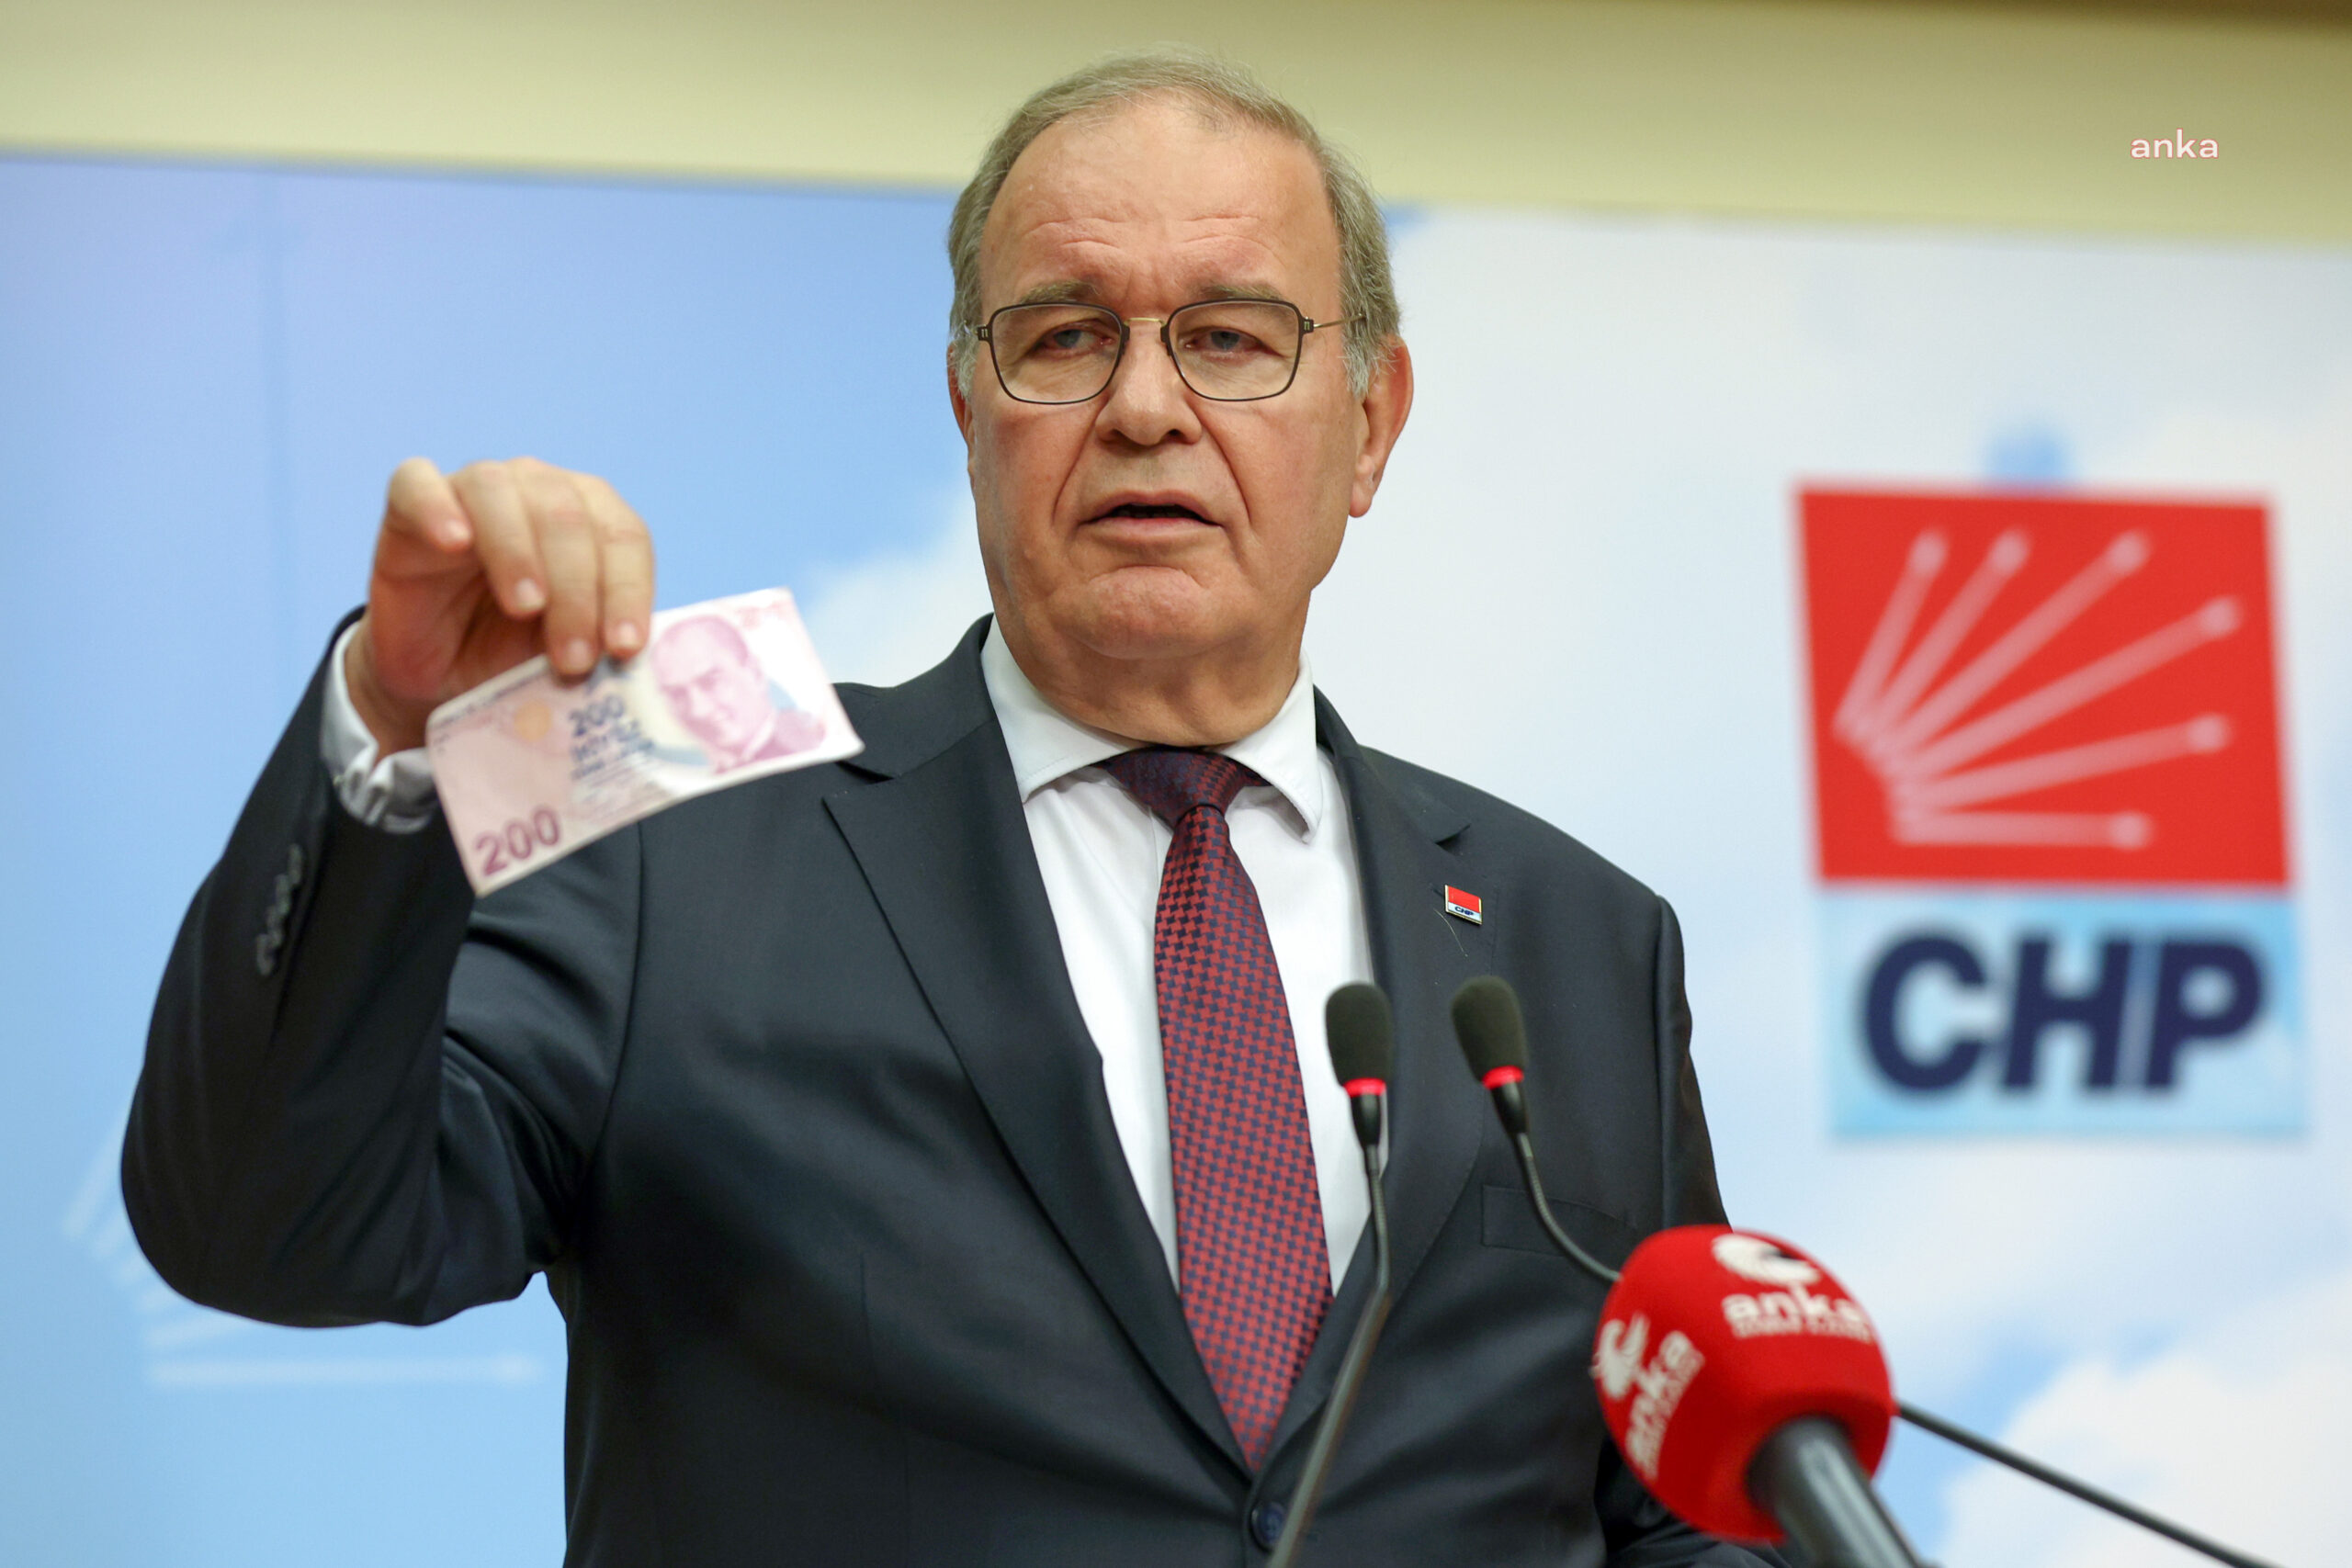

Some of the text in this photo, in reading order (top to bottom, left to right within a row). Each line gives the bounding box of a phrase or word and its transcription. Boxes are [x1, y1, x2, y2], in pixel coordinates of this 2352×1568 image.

[568, 694, 627, 738] 200
[475, 806, 561, 877] 200
[1858, 928, 2268, 1098] CHP
[1722, 1280, 1867, 1325] anka
